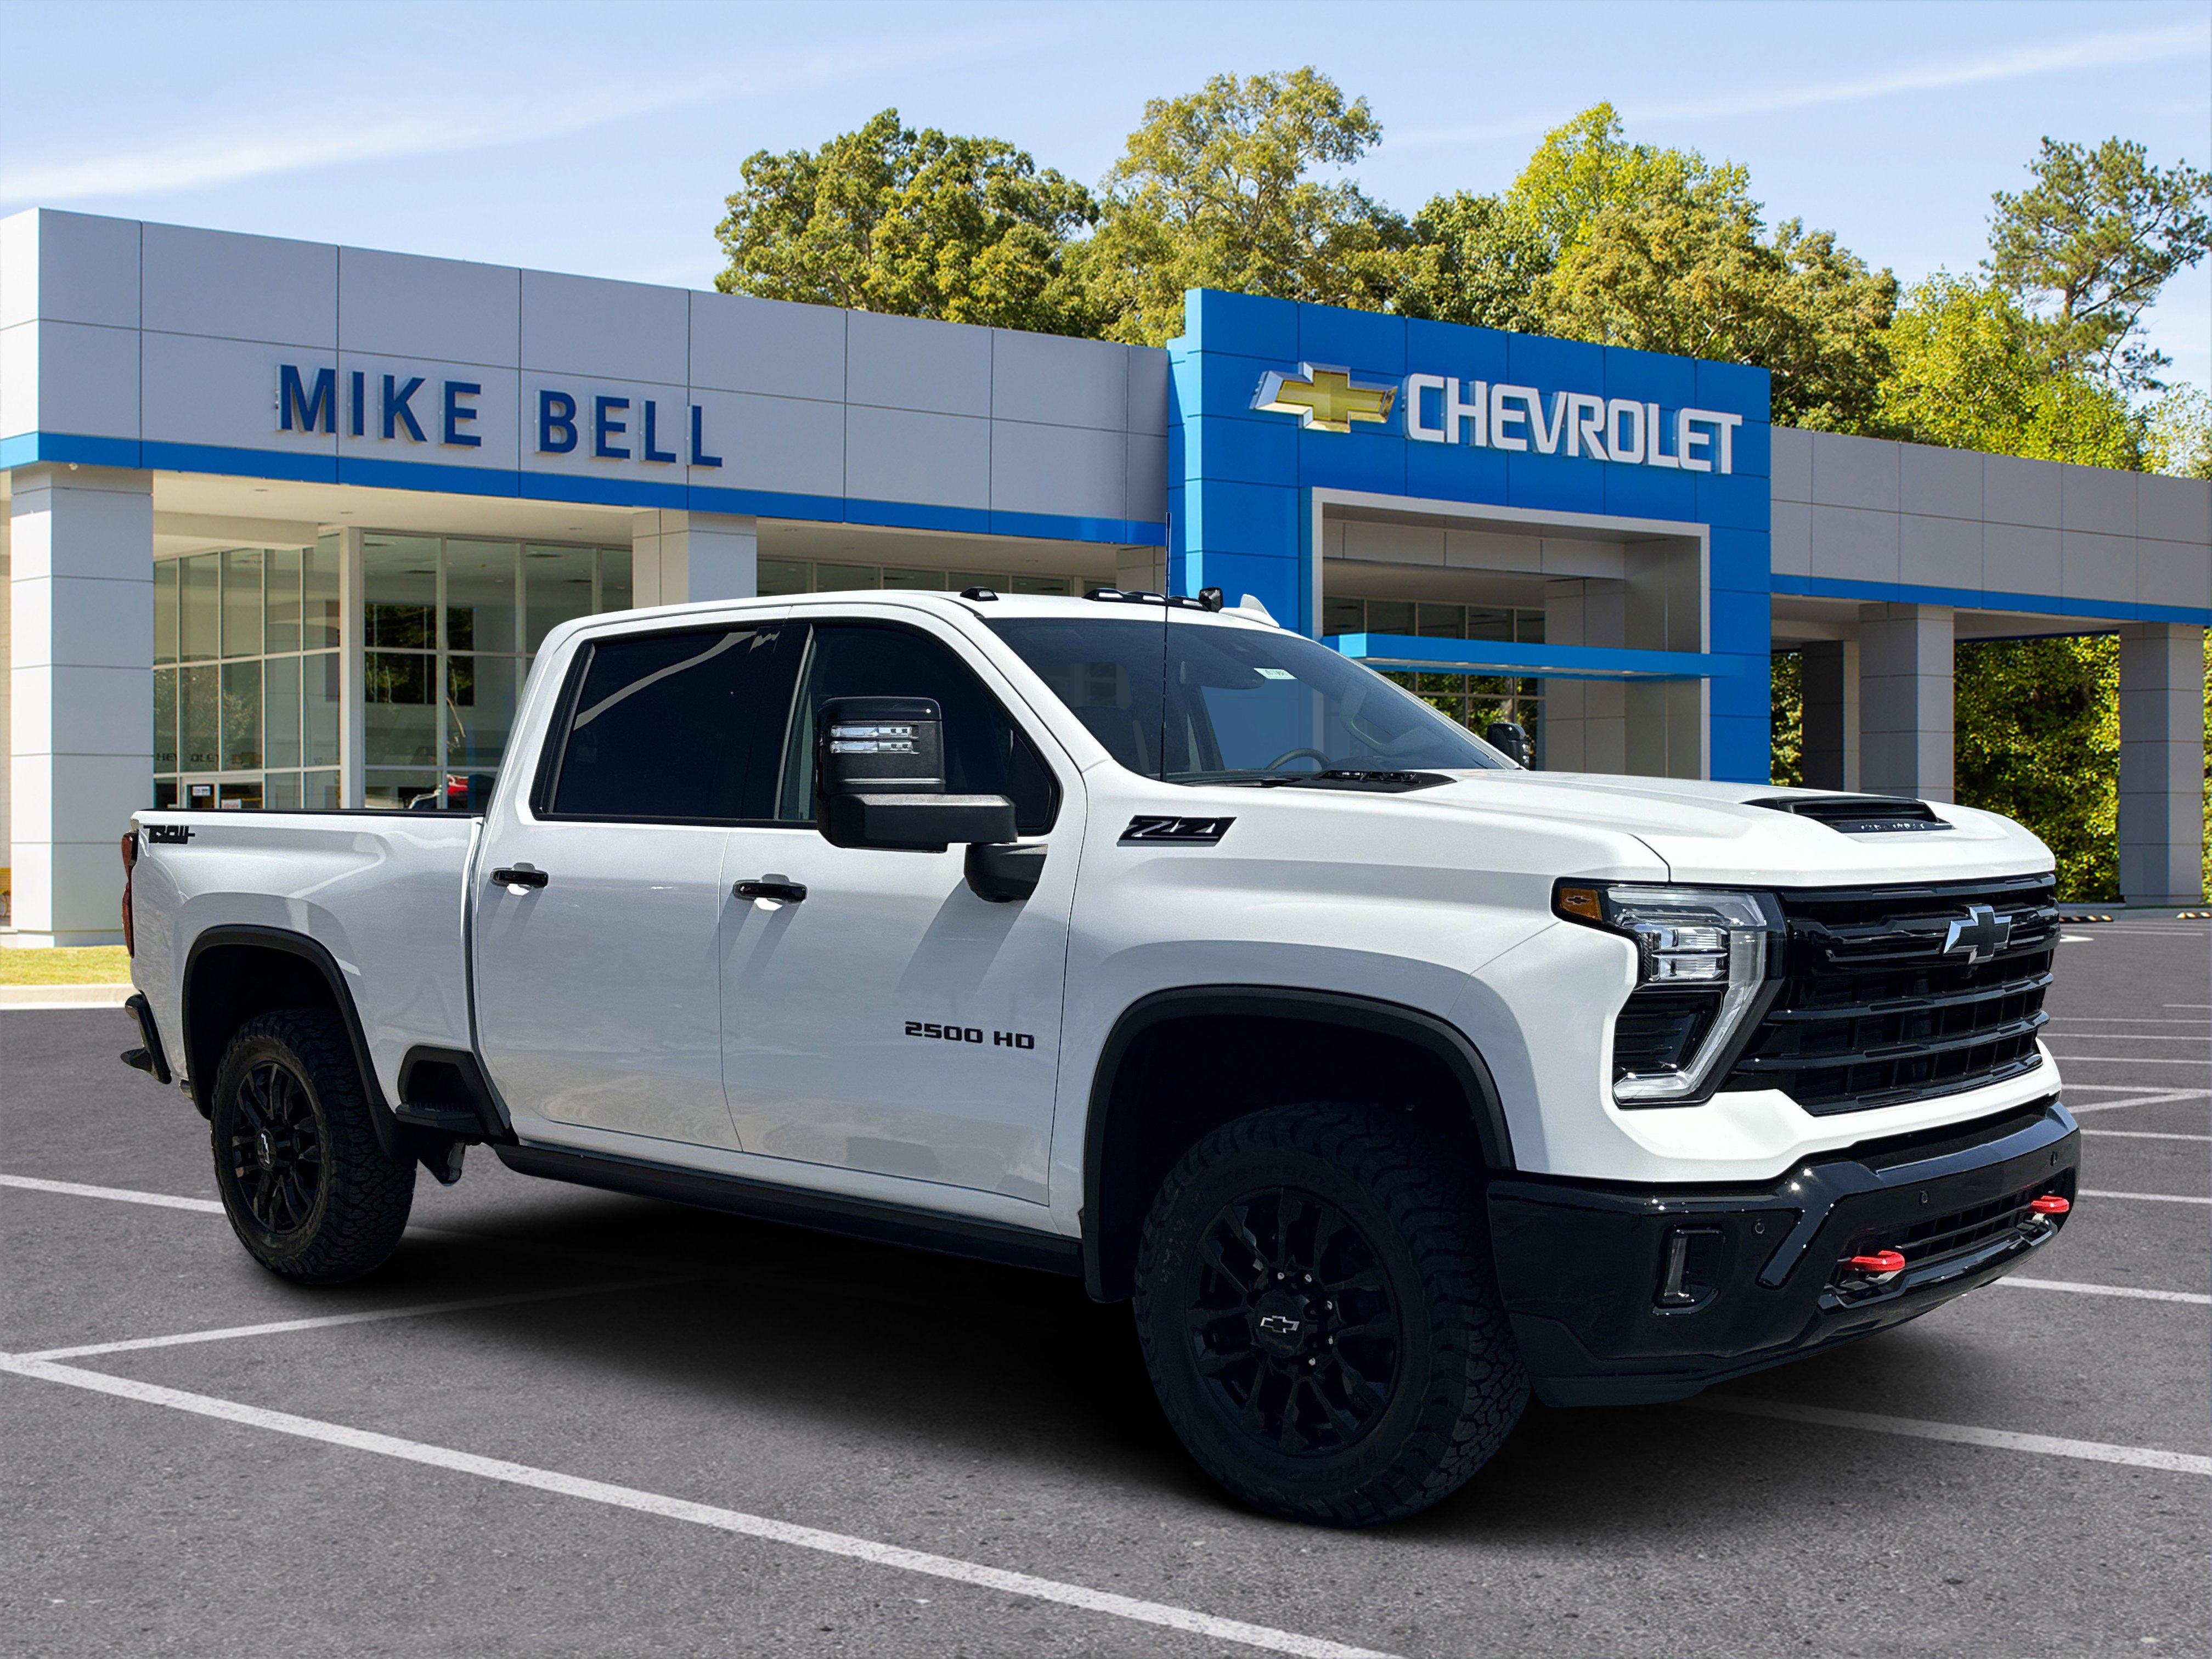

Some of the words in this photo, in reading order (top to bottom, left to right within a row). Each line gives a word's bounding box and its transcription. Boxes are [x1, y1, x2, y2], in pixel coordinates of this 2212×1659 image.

[275, 364, 482, 447] MIKE
[534, 390, 723, 468] BELL
[1404, 373, 1743, 475] CHEVROLET
[905, 1021, 983, 1043] 2500
[994, 1031, 1034, 1049] HD
